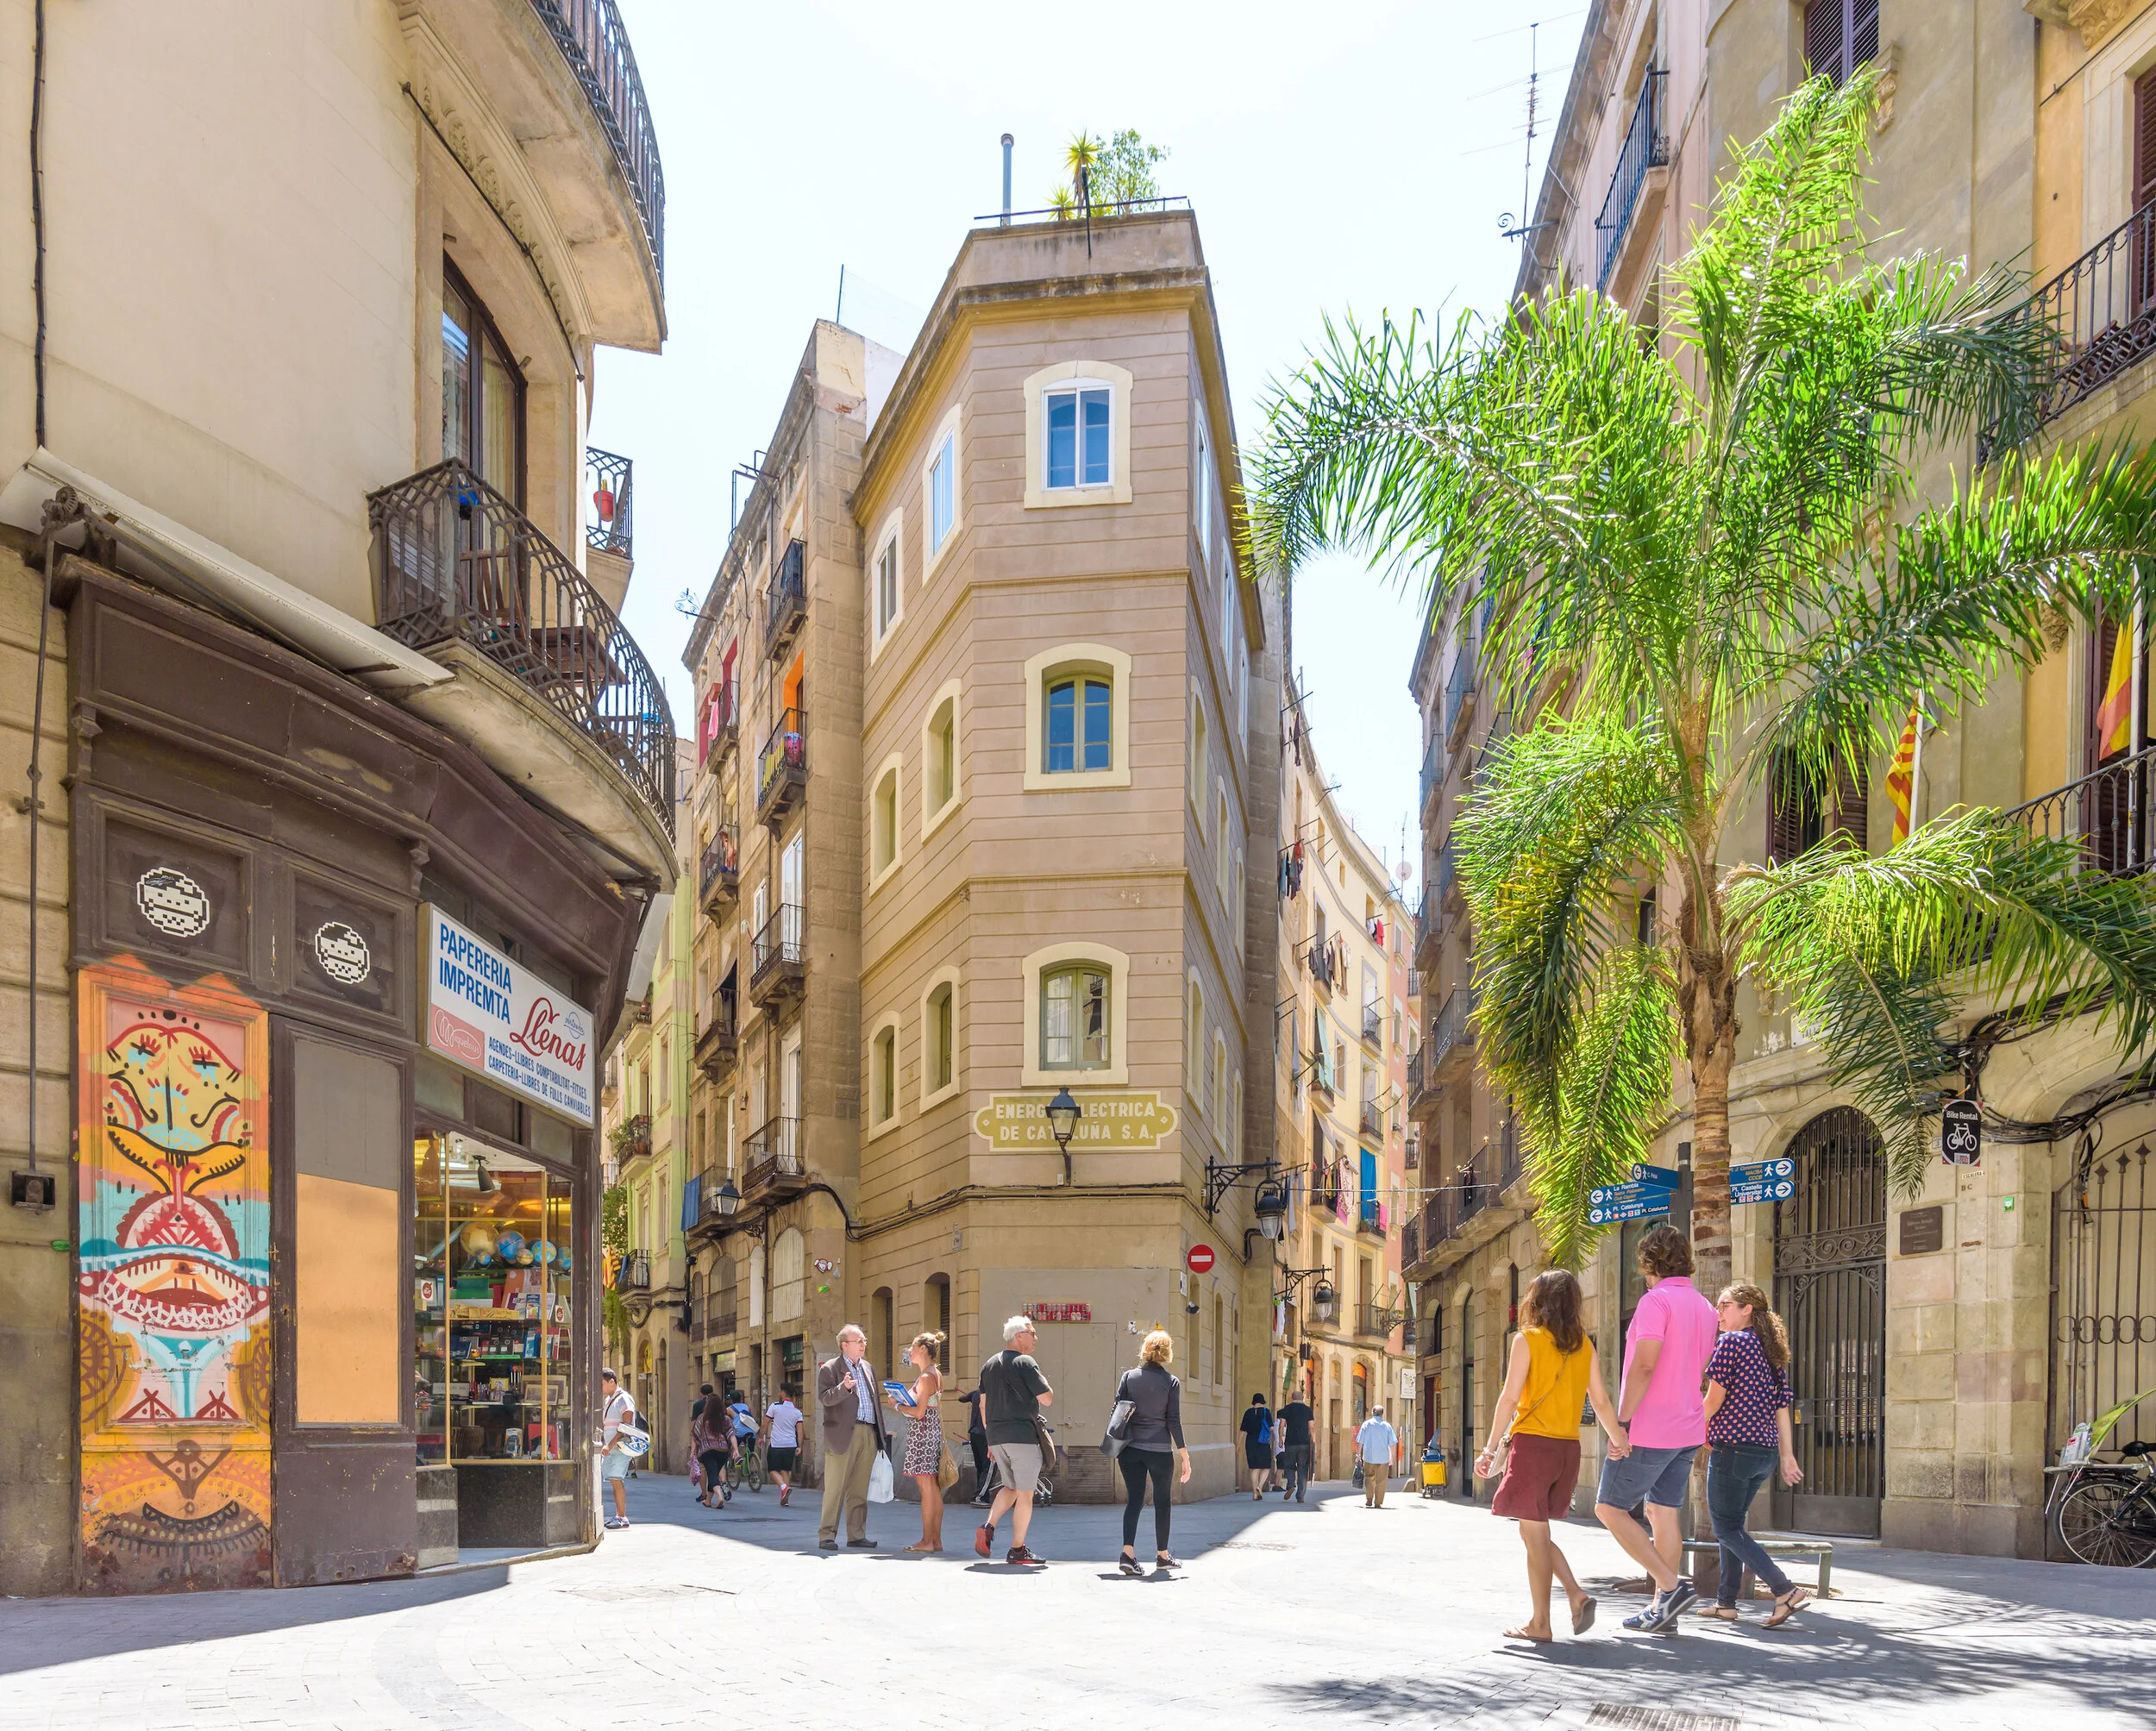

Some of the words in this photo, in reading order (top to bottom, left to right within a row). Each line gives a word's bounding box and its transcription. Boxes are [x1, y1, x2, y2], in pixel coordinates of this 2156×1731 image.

[440, 922, 512, 994] PAPERERIA
[439, 956, 511, 1025] IMPREMTA
[509, 996, 586, 1071] Llenas
[542, 1082, 548, 1096] DE
[549, 1086, 563, 1104] FULLS
[564, 1094, 592, 1118] CANVIABLES
[996, 1104, 1048, 1119] ENERG
[1076, 1101, 1156, 1119] LECTRICA
[1946, 1110, 1959, 1120] Bike
[1959, 1111, 1978, 1120] Rental
[1000, 1125, 1019, 1141] DE
[1026, 1121, 1112, 1141] CATUÑA
[1121, 1124, 1135, 1140] S.
[1138, 1124, 1154, 1139] A.
